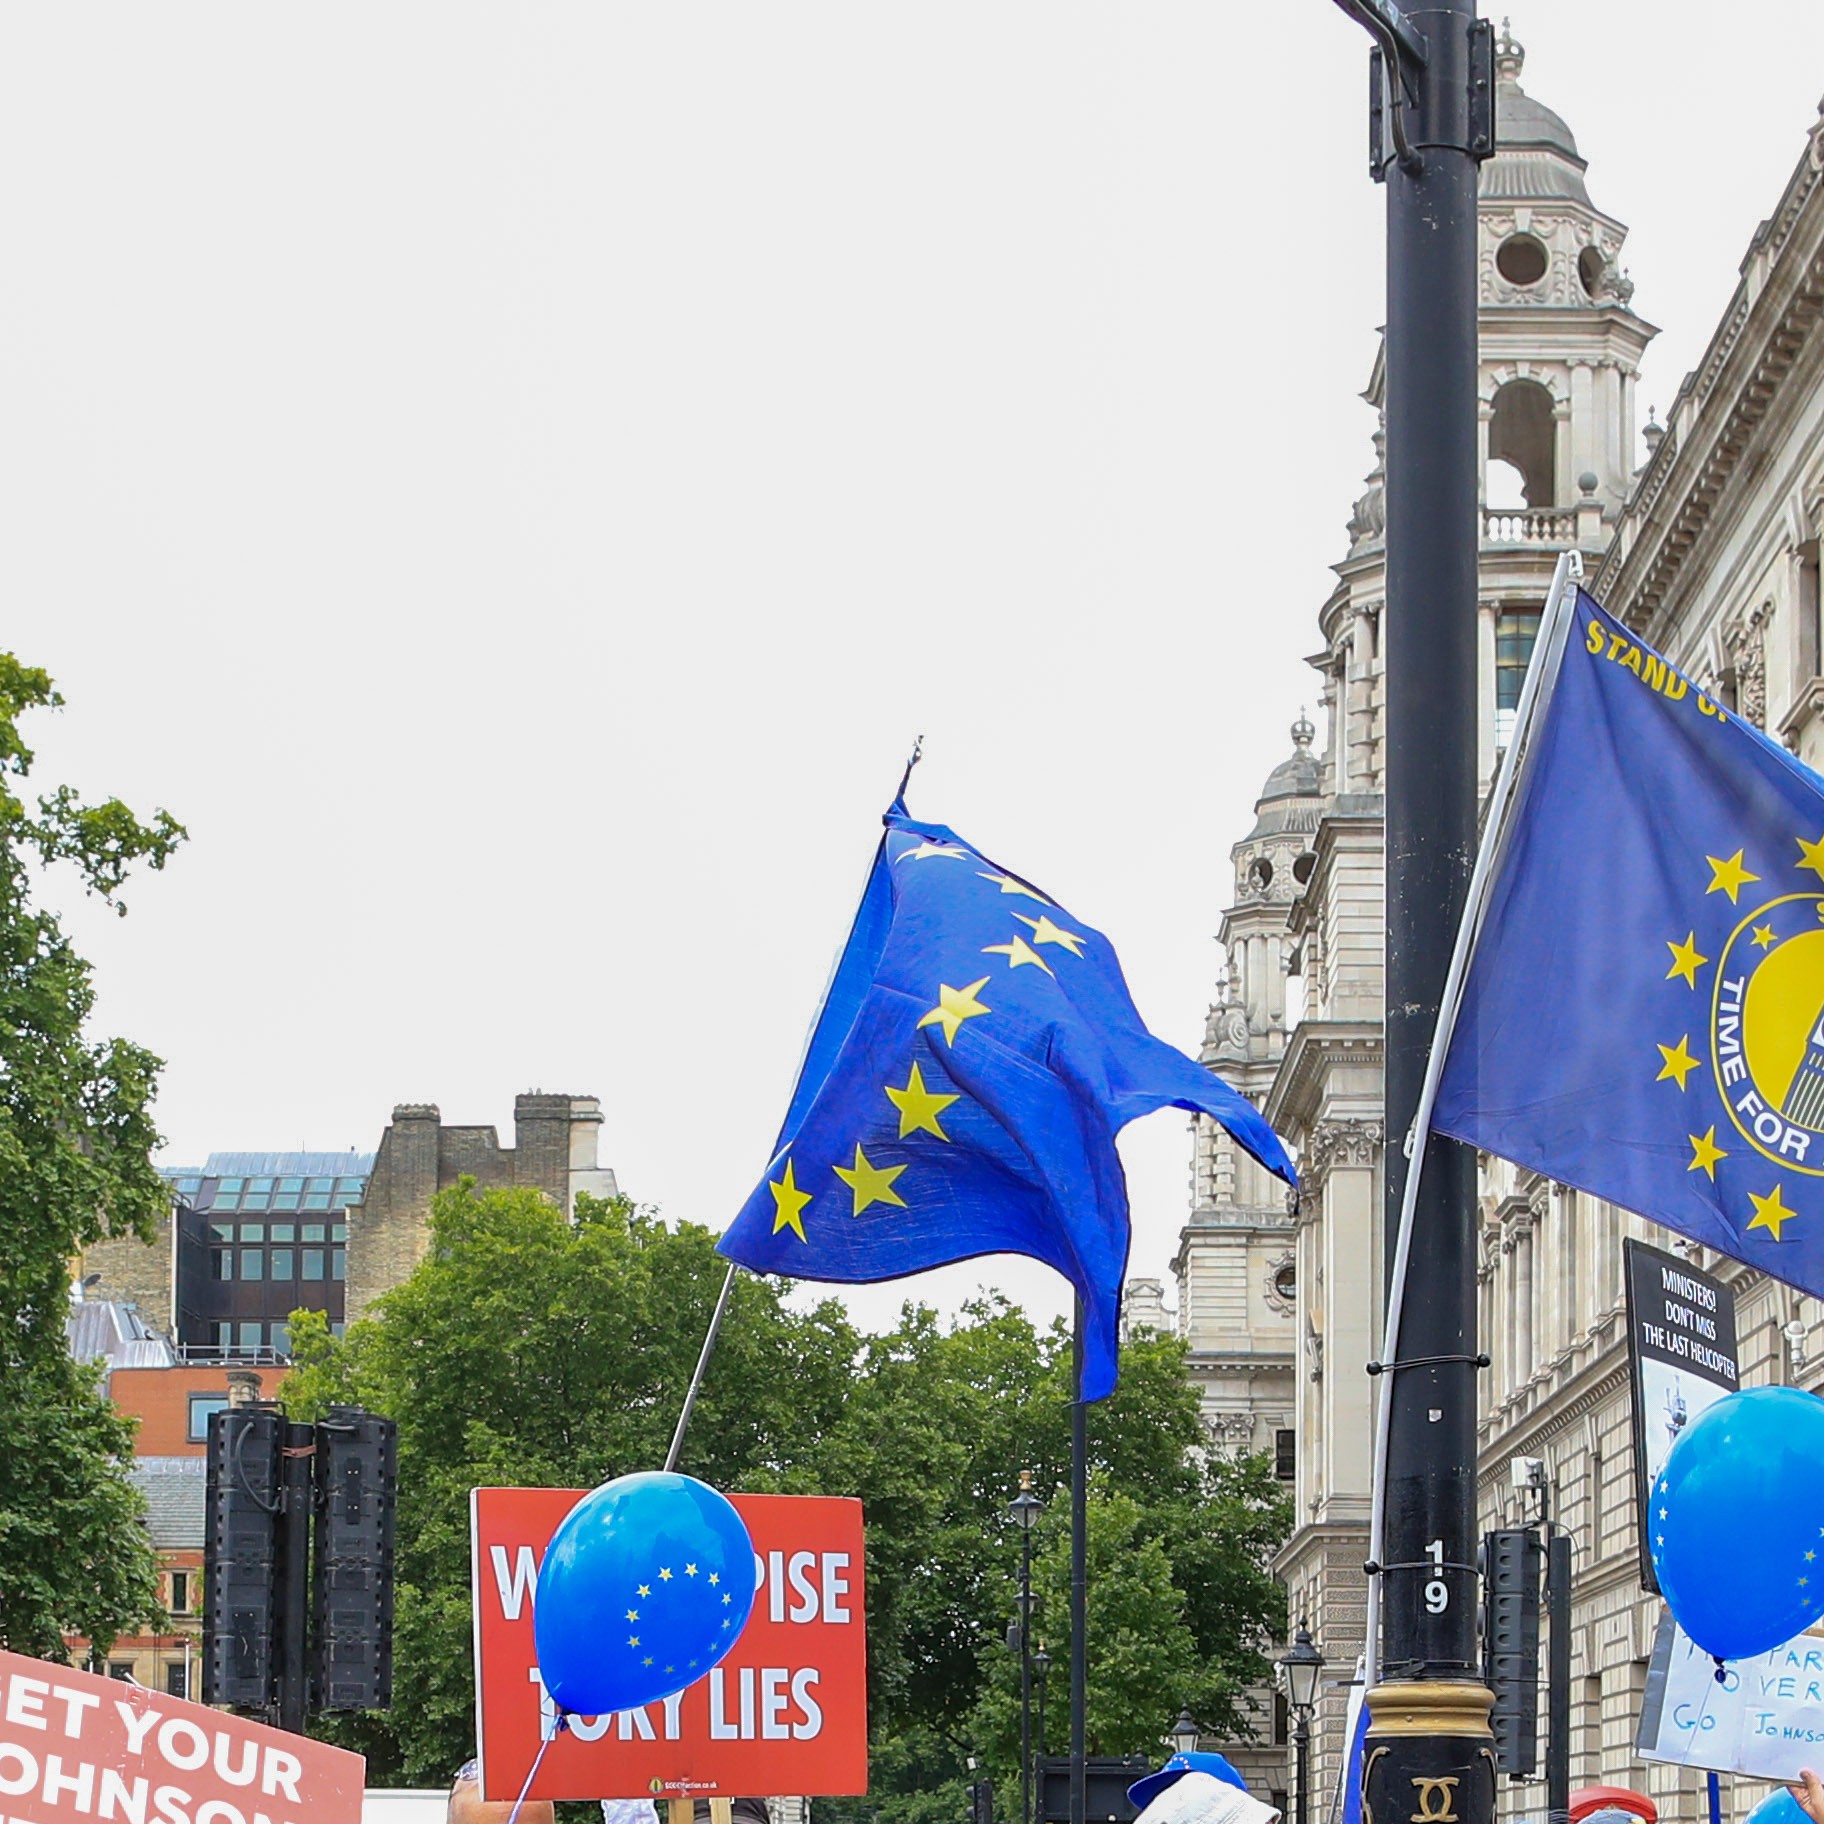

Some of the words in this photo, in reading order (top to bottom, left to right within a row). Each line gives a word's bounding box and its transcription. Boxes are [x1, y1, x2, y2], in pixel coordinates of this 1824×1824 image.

[1586, 620, 1688, 700] STAND
[1718, 976, 1747, 1087] TIME
[1736, 1090, 1810, 1161] FOR
[1661, 1267, 1717, 1313] MINISTERS!
[1665, 1300, 1694, 1331] DON'T
[1695, 1313, 1717, 1341] MISS
[1642, 1322, 1665, 1349] THE
[1666, 1331, 1689, 1358] LAST
[1690, 1340, 1736, 1381] HELICOPTER
[710, 1667, 823, 1741] LIES
[114, 1699, 303, 1804] YOUR
